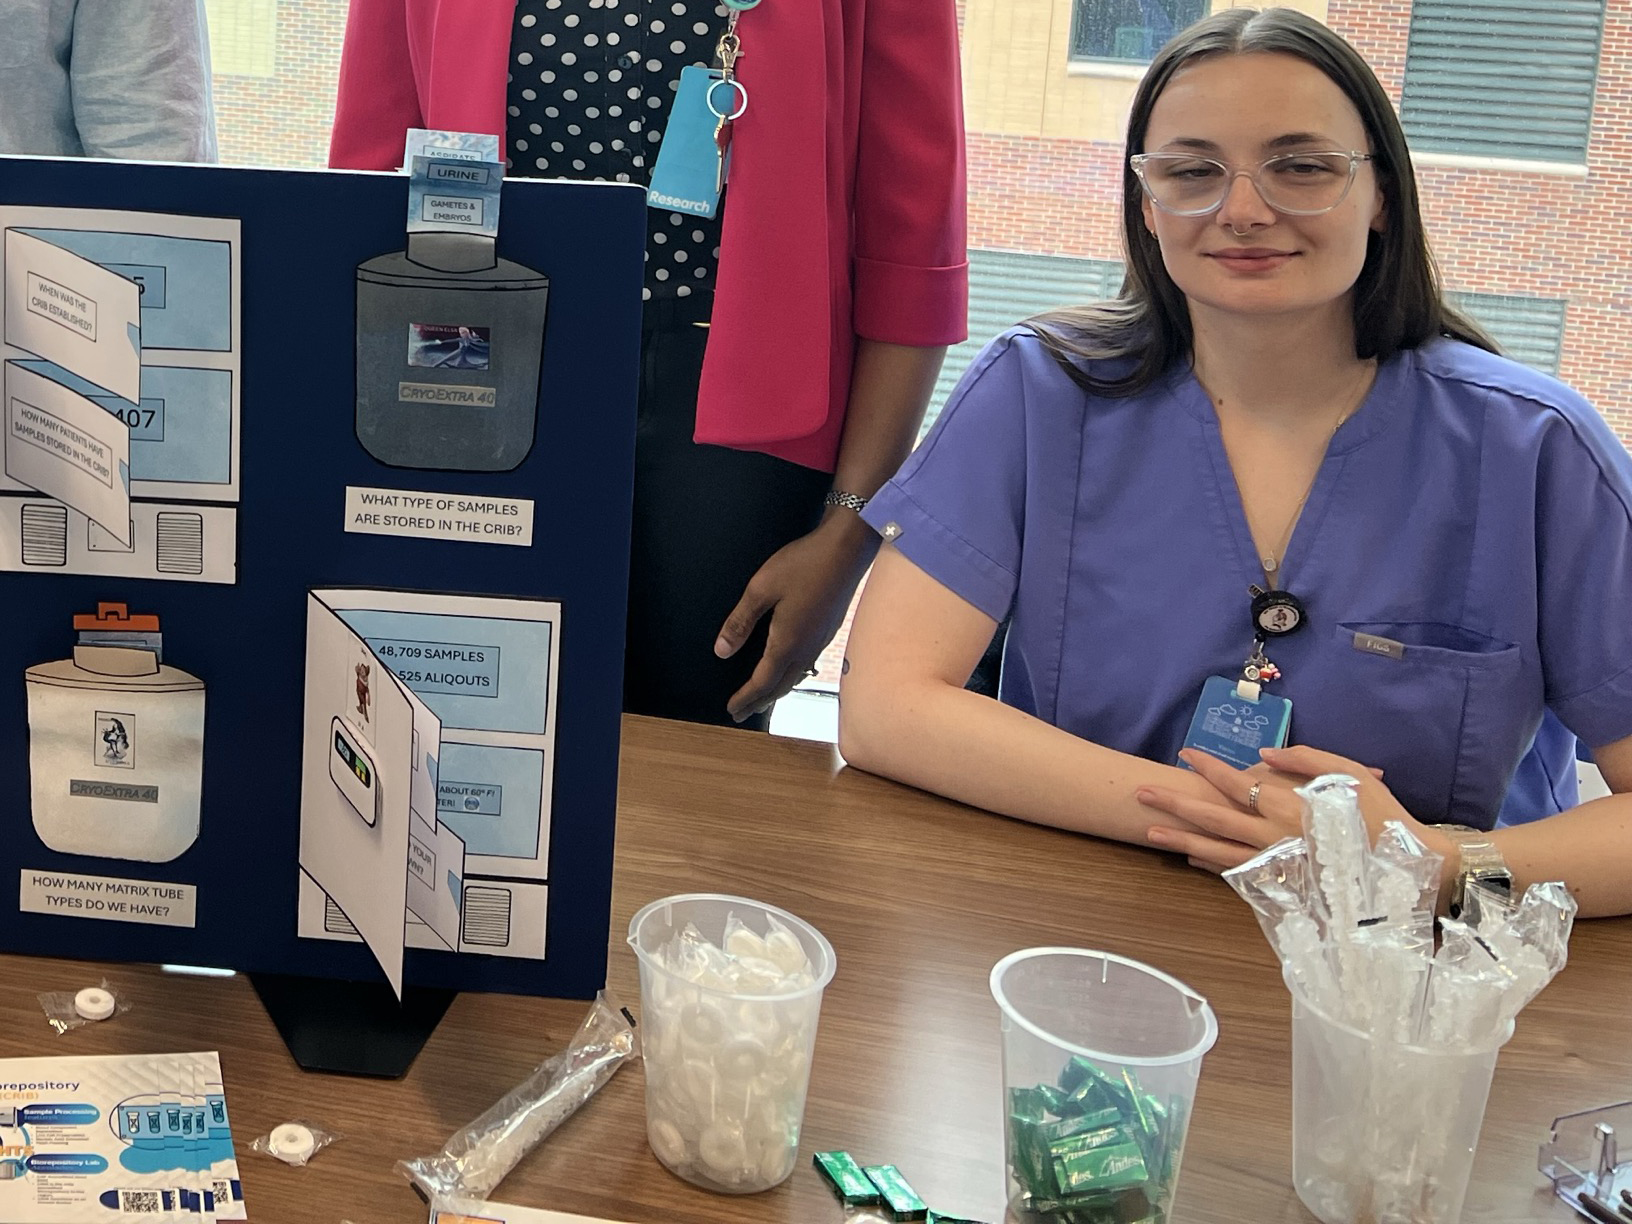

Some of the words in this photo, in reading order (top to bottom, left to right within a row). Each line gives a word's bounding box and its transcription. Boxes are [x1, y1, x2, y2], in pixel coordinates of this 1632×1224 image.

[438, 169, 479, 180] URINE
[431, 200, 468, 209] GAMETES
[649, 191, 710, 213] Research
[433, 213, 471, 222] EMBRYOS
[39, 282, 59, 298] WHEN
[60, 292, 74, 306] WAS
[75, 299, 86, 313] THE
[32, 297, 47, 311] CRIB
[49, 305, 92, 332] ESTABLISHED?
[477, 393, 494, 404] 40
[21, 408, 40, 424] HOW
[40, 415, 59, 431] MANY
[60, 426, 88, 448] PATIENTS
[88, 442, 103, 458] HAVE
[14, 422, 45, 443] SAMPLES
[47, 435, 72, 456] STORED
[73, 450, 80, 459] IN
[80, 454, 92, 468] THE
[361, 494, 399, 506] WHAT
[403, 497, 433, 509] TYPE
[436, 500, 455, 510] OF
[457, 501, 518, 516] SAMPLES
[355, 513, 380, 525] ARE
[383, 515, 435, 529] STORED
[438, 519, 452, 530] IN
[455, 521, 480, 533] THE
[483, 523, 522, 536] CRIB?
[379, 645, 422, 658] 48,709
[424, 649, 484, 662] SAMPLES
[424, 672, 490, 686] ALIQOUTS
[439, 786, 469, 795] ABOUT
[413, 843, 432, 866] YOUR
[32, 876, 64, 887] HOW
[67, 880, 103, 891] MANY
[106, 885, 150, 896] MATRIX
[152, 887, 184, 900] TUBE
[46, 895, 82, 908] TYPES
[86, 900, 104, 909] DO
[107, 902, 126, 913] WE
[130, 904, 169, 917] HAVE?
